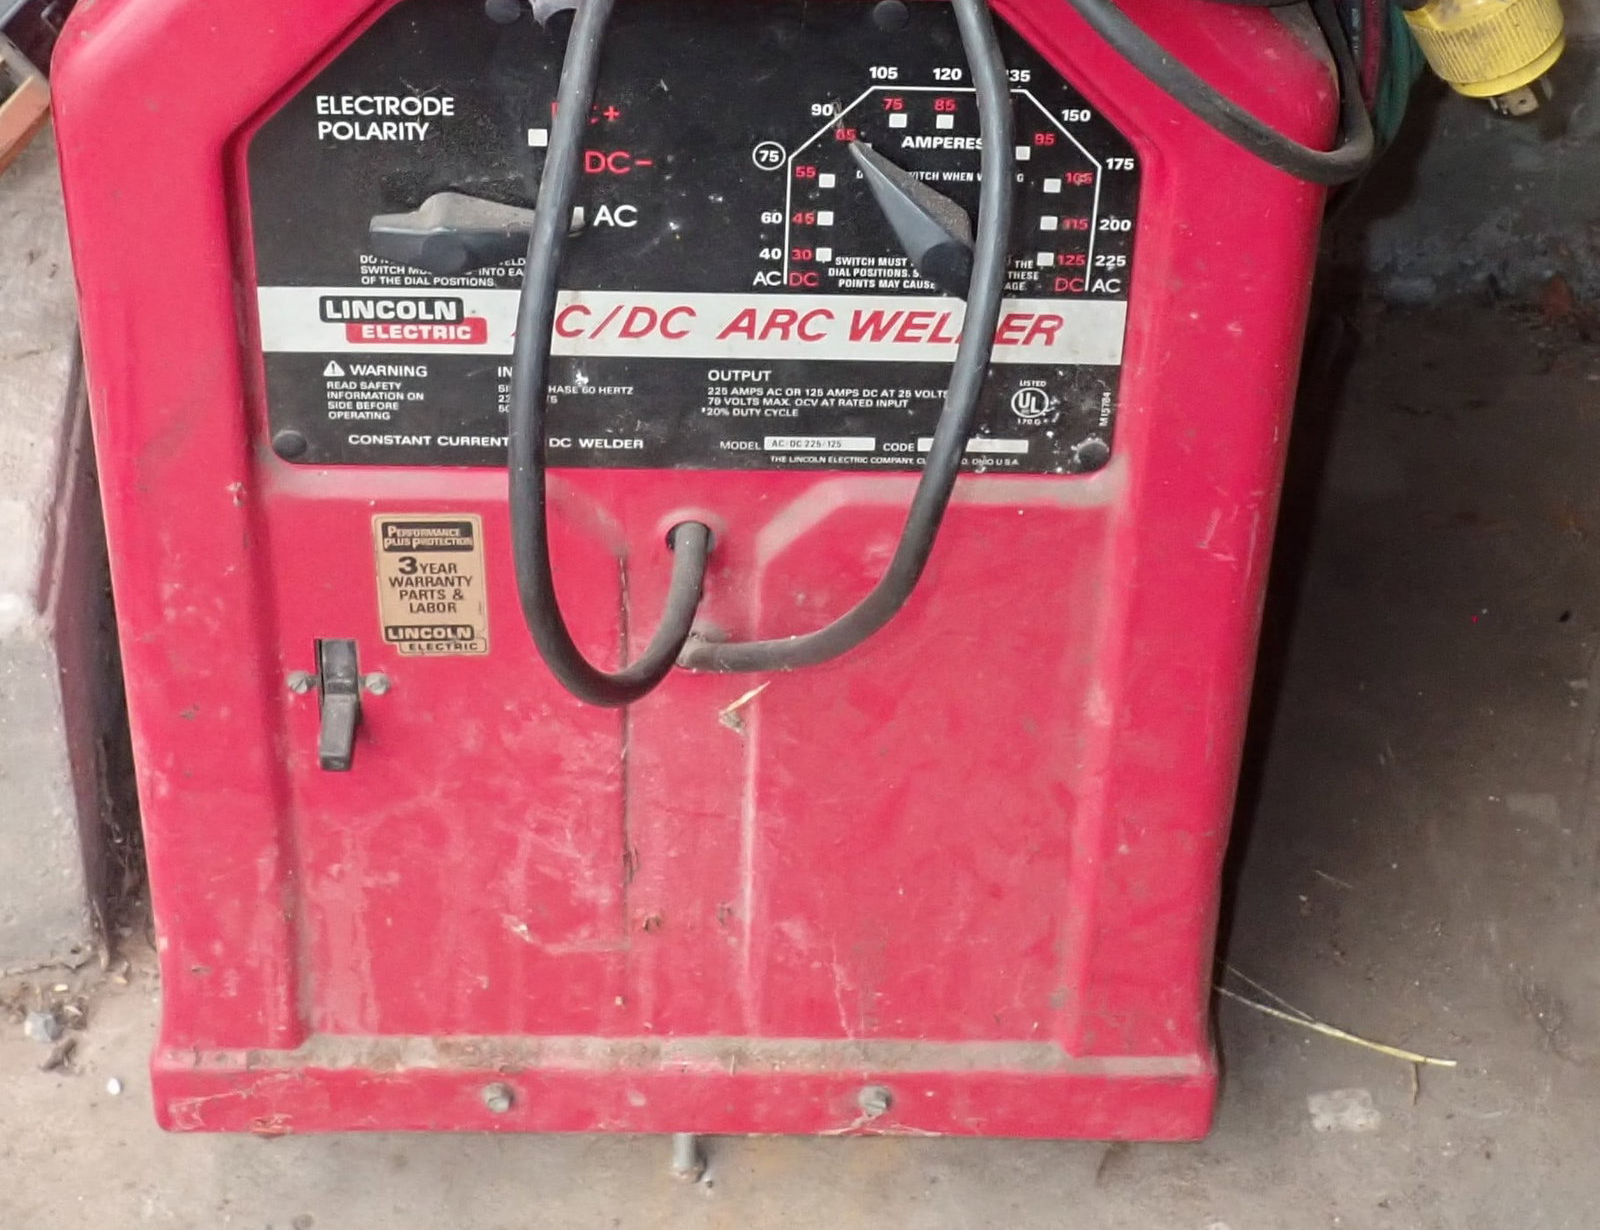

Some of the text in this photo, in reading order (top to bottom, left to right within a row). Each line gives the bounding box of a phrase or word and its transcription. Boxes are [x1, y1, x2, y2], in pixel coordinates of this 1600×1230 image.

[869, 66, 898, 80] 105
[933, 68, 962, 81] 120
[1006, 69, 1031, 82] 35
[316, 95, 455, 116] ELECTRODE
[811, 103, 834, 117] 90
[884, 98, 904, 111] 75
[934, 98, 956, 111] 85
[1061, 109, 1091, 122] 150
[318, 121, 429, 141] POLARITY
[835, 128, 857, 142] 65
[901, 136, 983, 150] AMPERES
[1034, 133, 1056, 146] 95
[758, 150, 780, 163] 75
[1106, 158, 1135, 171] 175
[795, 166, 817, 179] 55
[942, 172, 974, 182] WHEN
[1065, 172, 1094, 184] 105
[593, 204, 638, 227] AC
[761, 212, 783, 224] 60
[792, 212, 815, 225] 45
[1099, 219, 1132, 231] 200
[759, 248, 782, 260] 40
[791, 249, 813, 261] 30
[1057, 254, 1086, 266] 125
[835, 257, 908, 266] SWITCH MUST
[1014, 260, 1034, 269] THE
[1095, 255, 1127, 267] 225
[360, 266, 405, 275] SWITCH
[478, 268, 505, 277] INTO
[508, 268, 524, 277] EA
[828, 268, 850, 277] DIAL
[853, 268, 911, 278] POSITIONS.
[1007, 271, 1039, 281] THESE
[361, 276, 376, 286] OF
[379, 277, 401, 286] THE
[404, 277, 431, 286] DIAL
[753, 271, 782, 286] AC
[789, 272, 819, 287] DC
[838, 279, 875, 288] POINTS
[878, 279, 901, 288] MAY
[1054, 277, 1084, 292] DC
[1091, 278, 1121, 292] AC
[325, 299, 457, 320] LINCOLN
[511, 304, 1064, 346] C/DC ARC WELER
[361, 324, 472, 340] ELECTRIC
[350, 364, 428, 377] WARNING
[708, 370, 772, 382] OUTPUT
[326, 381, 401, 390] READ SAFETY
[548, 385, 634, 395] HASE 60 HERTZ
[327, 392, 424, 401] INFORMATION ON
[707, 387, 728, 396] 225
[731, 387, 764, 396] AMPS
[766, 388, 782, 397] AC
[785, 388, 802, 397] OR
[805, 388, 823, 397] 125
[826, 388, 860, 397] AMPS
[862, 389, 878, 398] DC
[880, 389, 896, 398] AT
[898, 389, 912, 398] 25
[328, 401, 399, 411] SIDE BEFORE
[724, 397, 760, 406] VOLTS
[794, 398, 819, 407] OCV
[820, 398, 836, 407] AT
[838, 399, 873, 408] RATED
[876, 399, 909, 408] INPUT
[1018, 392, 1041, 413] UL
[328, 411, 391, 420] OPERATING
[707, 407, 799, 417] 20% DUTY CYCLE
[348, 434, 509, 447] CONSTANT CURRENT
[578, 438, 644, 449] WELDER
[720, 440, 761, 450] MODEL
[883, 442, 915, 452] CODE
[771, 455, 786, 464] THE
[789, 456, 826, 464] LINCOLN
[828, 456, 868, 464] ELECTRIC
[387, 526, 461, 537] PERFORMANCE
[398, 556, 457, 575] 3 YEAR
[389, 576, 473, 587] WARRANTY
[399, 589, 464, 600] PARTS &
[409, 602, 457, 613] LABOR
[388, 627, 472, 639] LINCOLN
